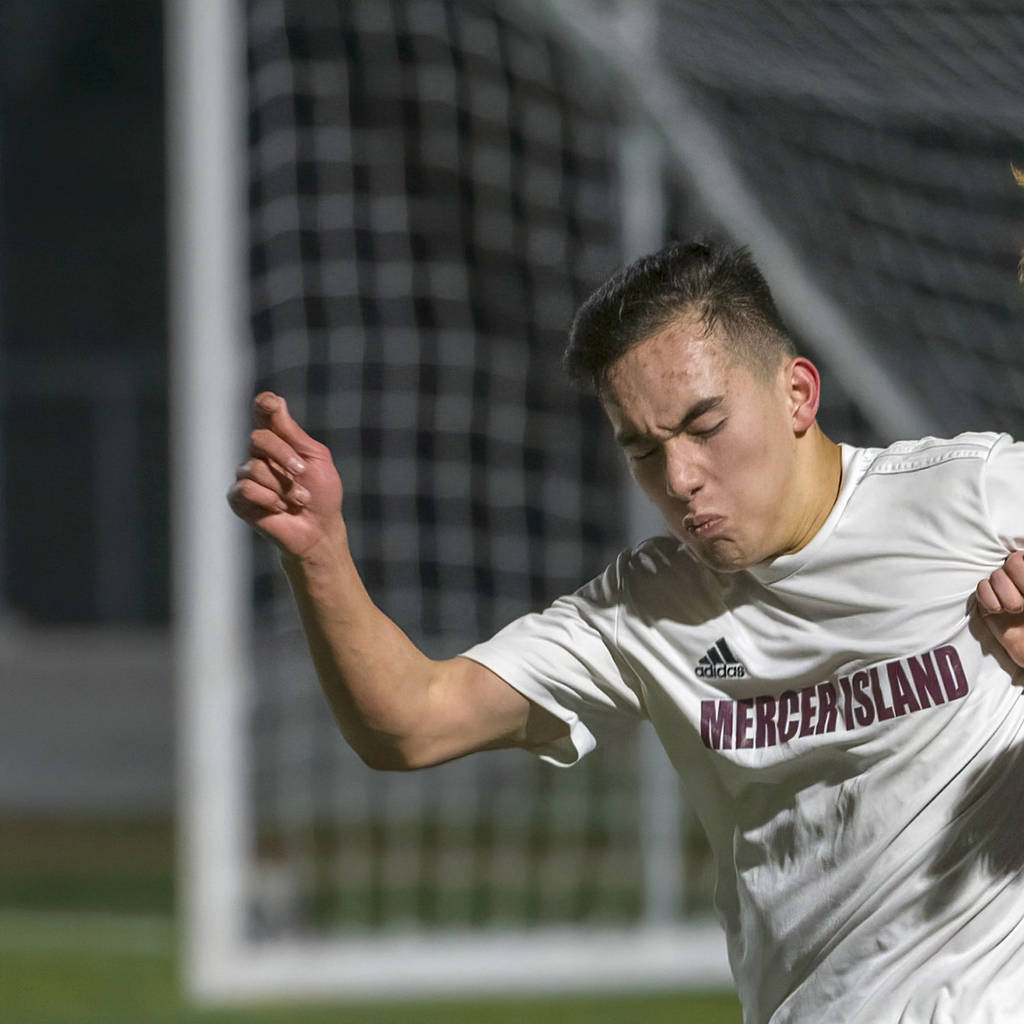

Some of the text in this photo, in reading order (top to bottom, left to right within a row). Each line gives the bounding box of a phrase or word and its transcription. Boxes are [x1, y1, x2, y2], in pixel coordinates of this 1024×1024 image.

[695, 663, 745, 678] adidas
[700, 645, 970, 750] MERCER ISLAND
